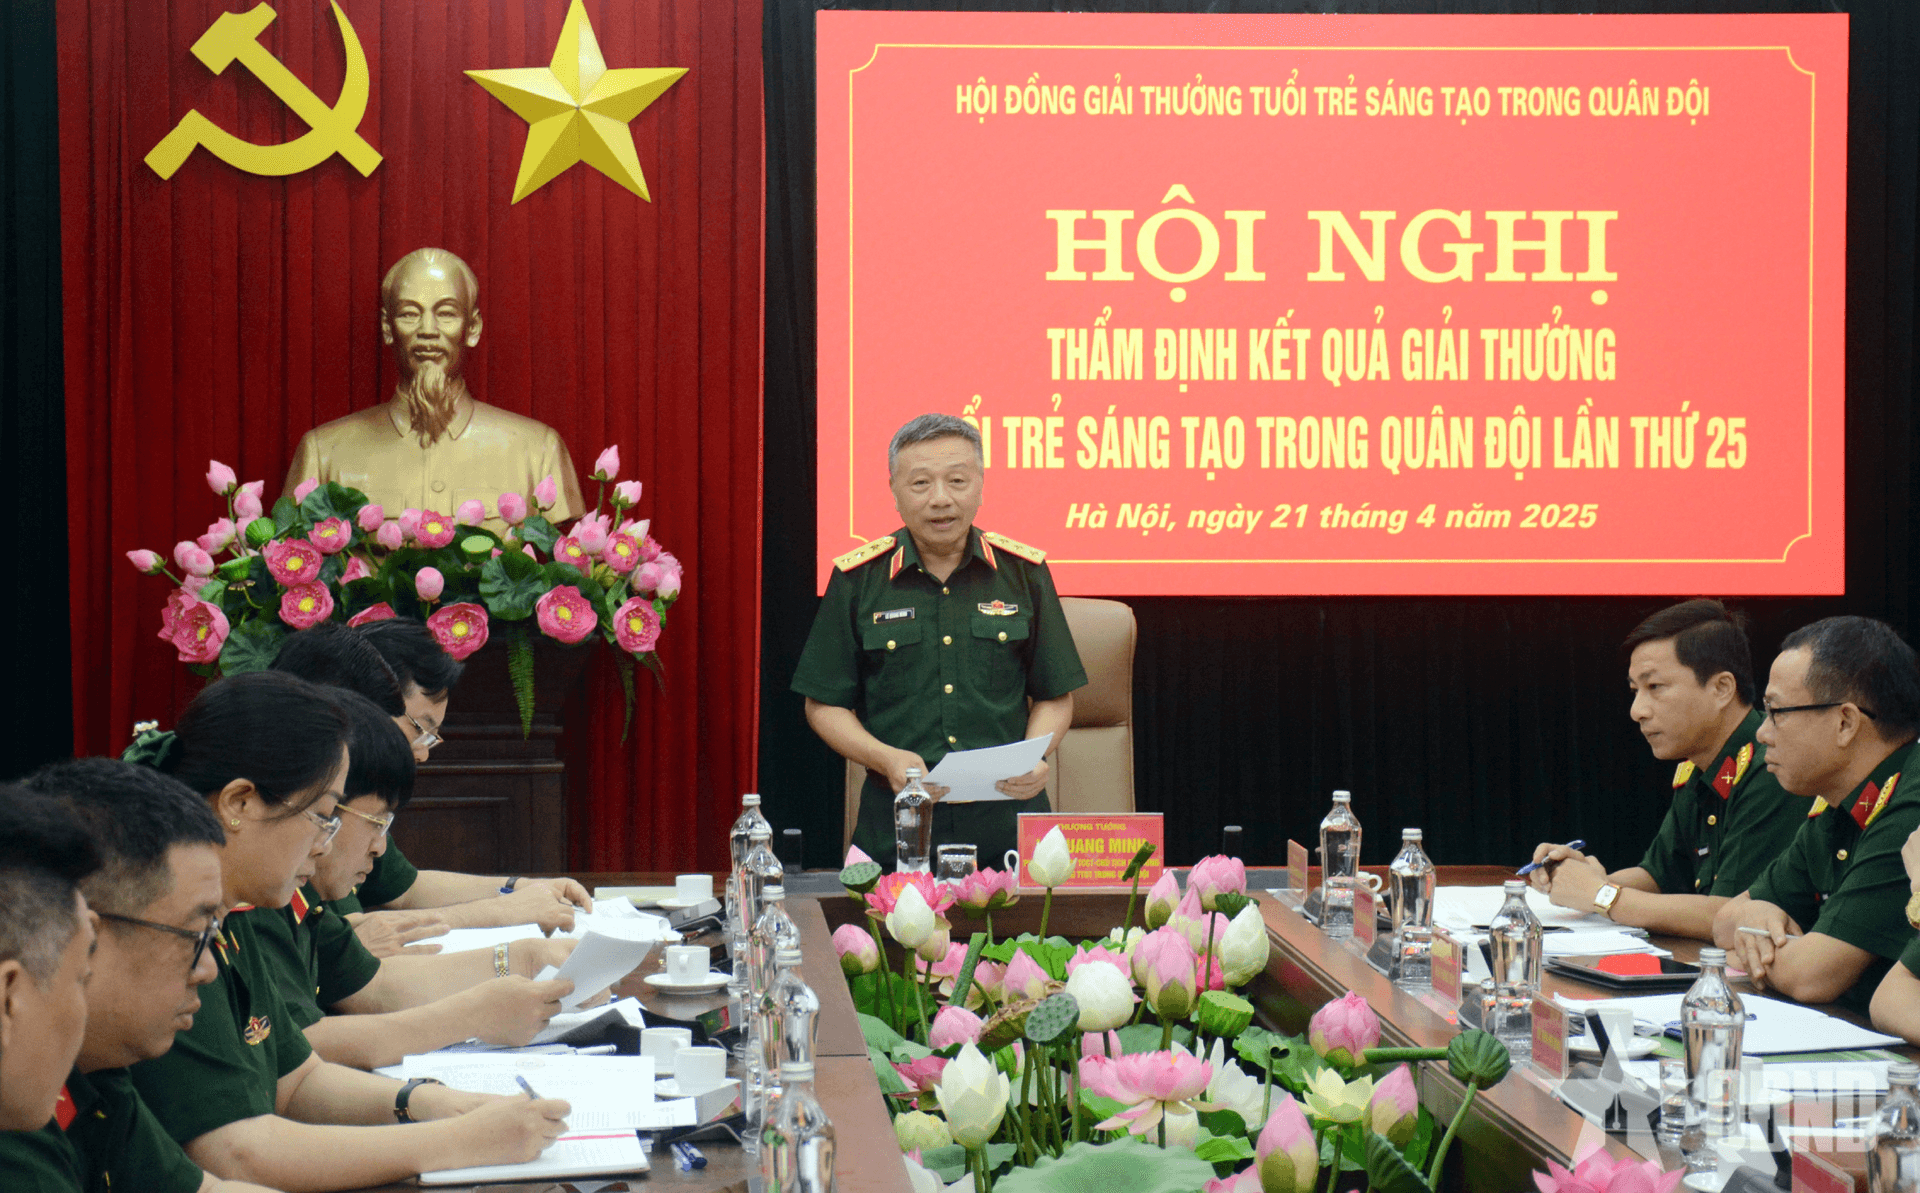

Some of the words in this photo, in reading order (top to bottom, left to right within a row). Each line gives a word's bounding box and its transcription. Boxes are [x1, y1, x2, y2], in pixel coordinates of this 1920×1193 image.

[956, 76, 998, 125] HỘI
[1003, 72, 1077, 116] ĐỒNG
[1083, 73, 1134, 116] GIẢI
[1139, 73, 1243, 117] THƯỞNG
[1248, 69, 1307, 117] TUỔI
[1313, 73, 1358, 117] TRẺ
[1364, 78, 1434, 117] SÁNG
[1440, 86, 1491, 126] TẠO
[1497, 86, 1581, 117] TRONG
[1587, 78, 1660, 117] QUÂN
[1665, 78, 1710, 126] ĐỘI
[1045, 183, 1267, 303] HỘI
[1306, 208, 1619, 306] NGHỊ
[1046, 305, 1144, 381] THẨM
[1153, 327, 1238, 393] ĐỊNH
[1248, 308, 1312, 381] KẾT
[1321, 304, 1391, 388] QUẢ
[1401, 304, 1470, 382] GIẢI
[1479, 304, 1617, 382] THƯỞNG
[1002, 392, 1065, 469] TRẺ
[1076, 404, 1171, 470] SÁNG
[1180, 415, 1246, 482] TẠO
[1255, 415, 1369, 470] TRONG
[1380, 404, 1474, 476] QUÂN
[1483, 404, 1542, 481] ĐỘI
[1553, 397, 1620, 469] LẦN
[1629, 400, 1700, 470] THỨ
[1705, 417, 1748, 470] 25
[1065, 502, 1109, 529] Hà
[1115, 502, 1177, 537] Nội,
[1186, 502, 1264, 535] ngày
[1269, 503, 1309, 529] 21
[1319, 502, 1409, 535] tháng
[1415, 503, 1437, 528] 4
[1444, 502, 1512, 529] năm
[1519, 503, 1599, 529] 2025
[1066, 837, 1105, 854] UANG
